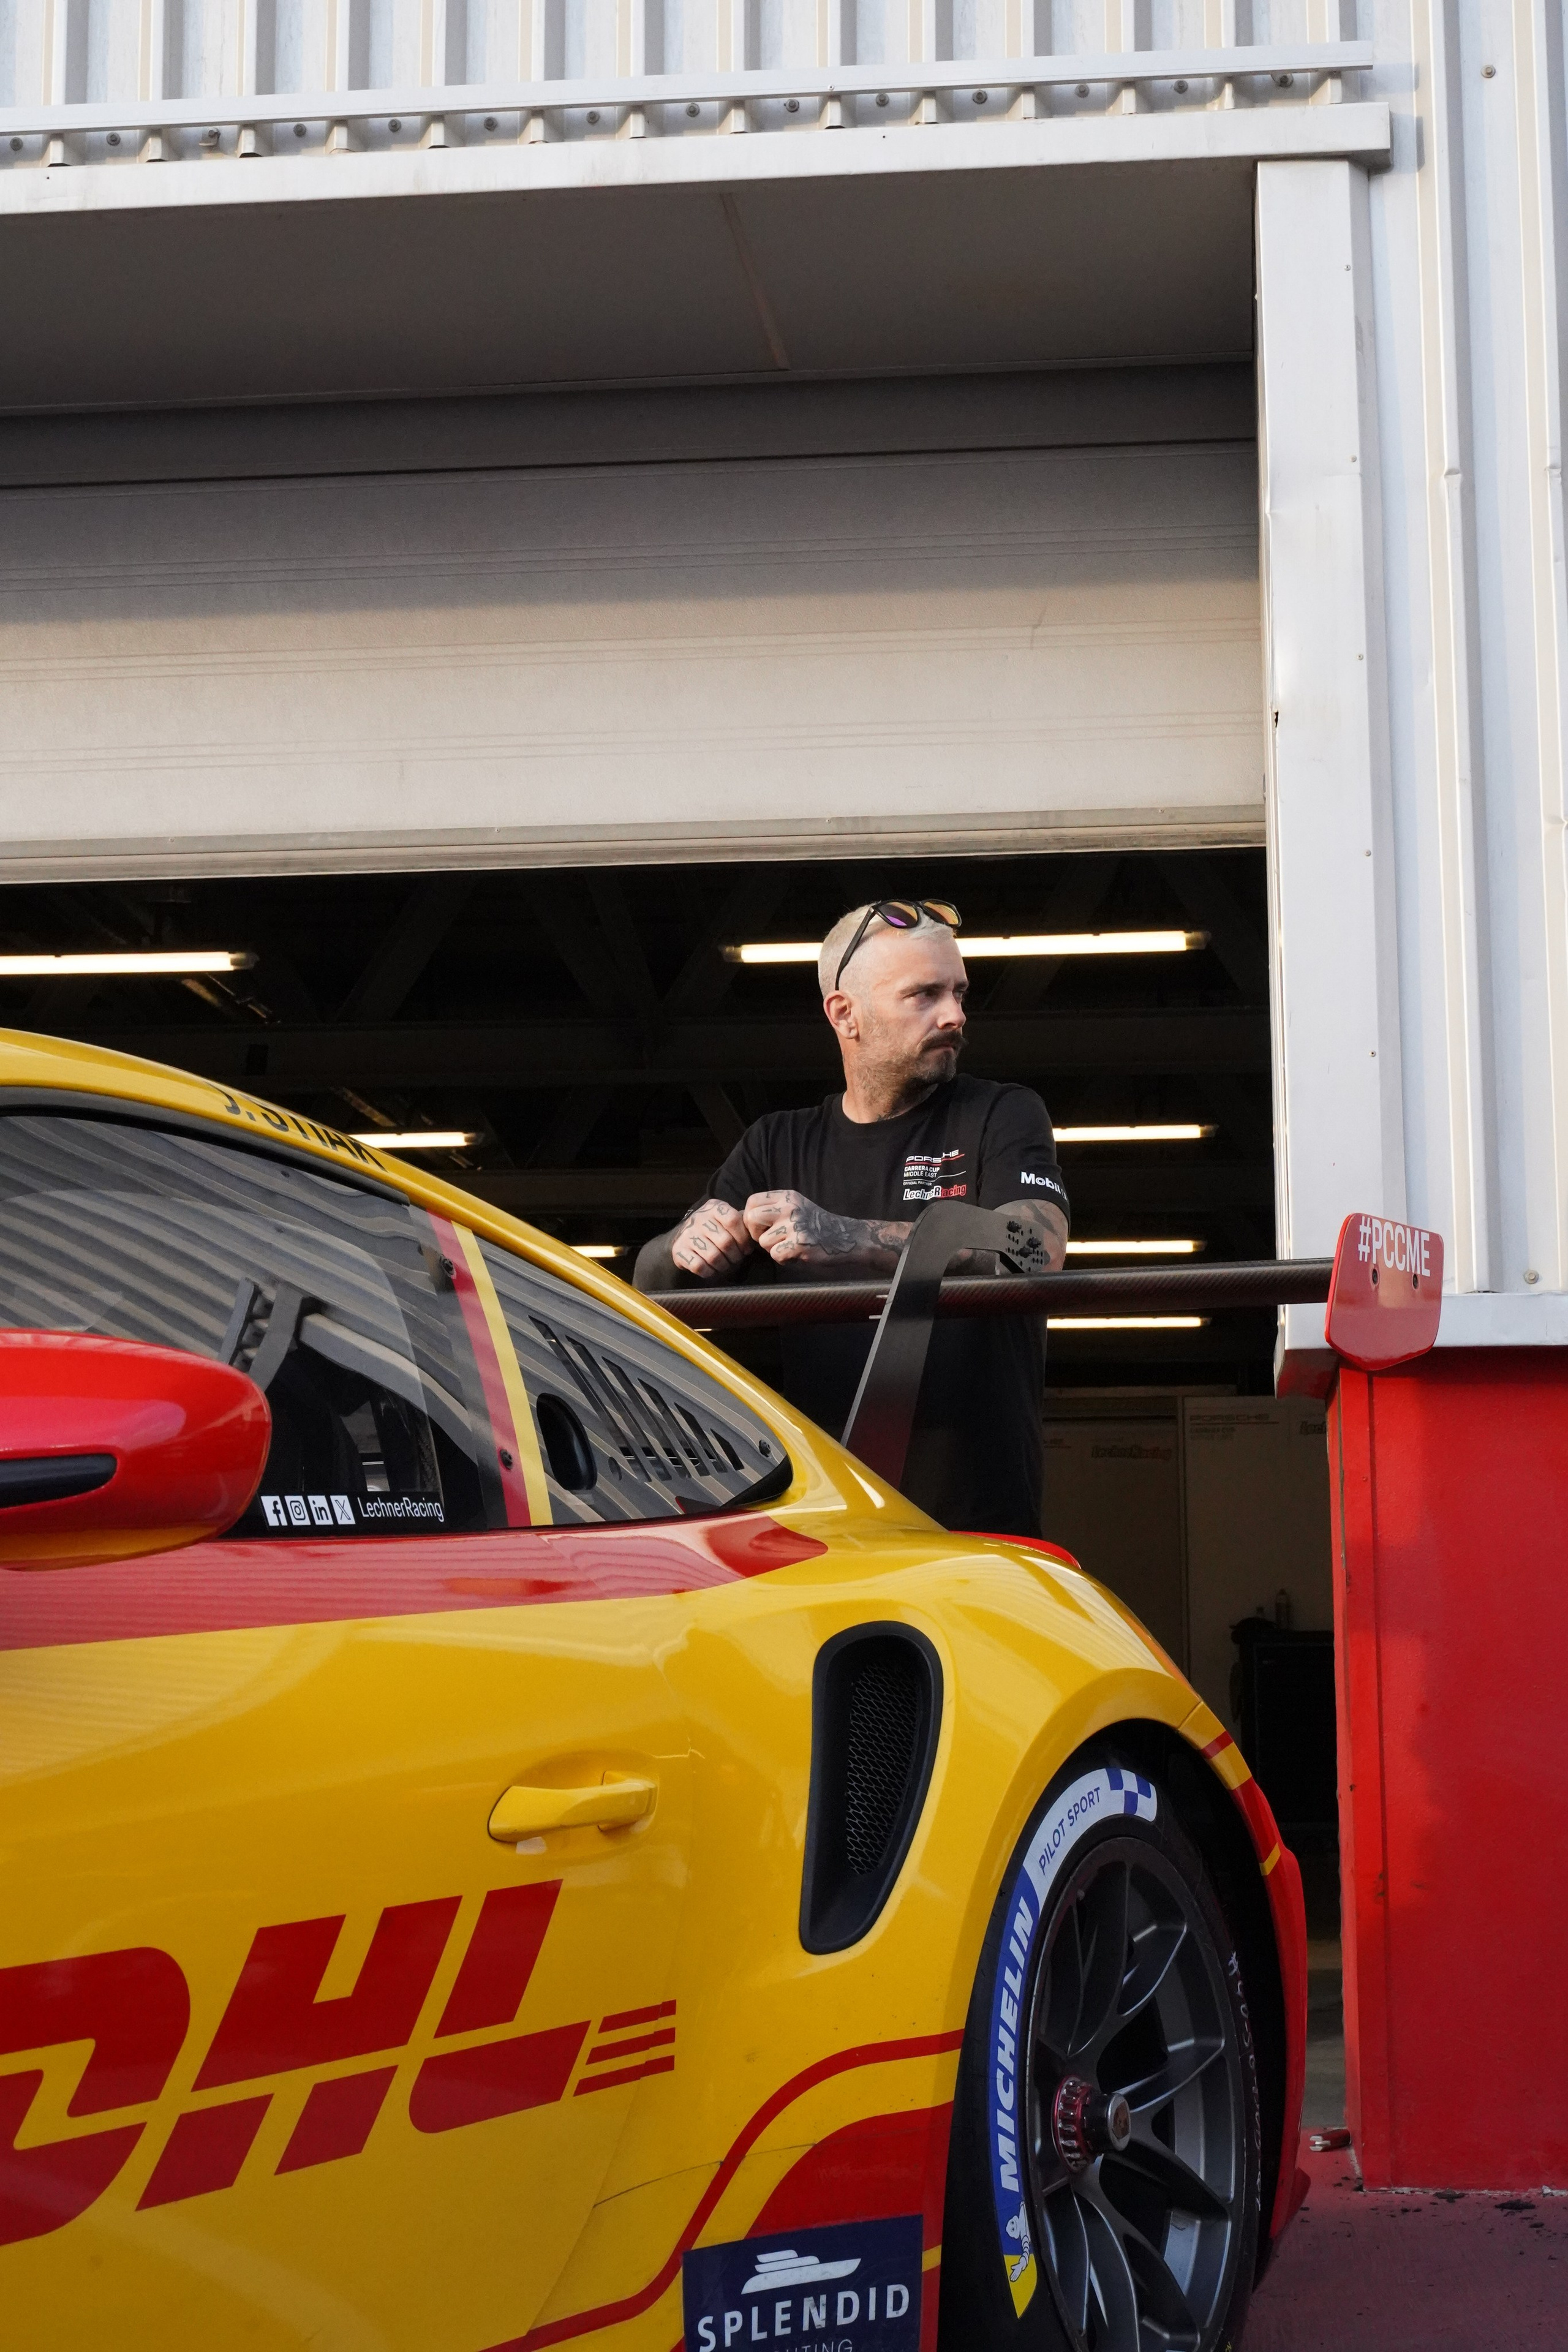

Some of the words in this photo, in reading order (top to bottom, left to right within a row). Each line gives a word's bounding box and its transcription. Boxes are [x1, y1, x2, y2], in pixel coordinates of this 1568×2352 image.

[905, 1149, 959, 1163] PORSHE
[1020, 1171, 1061, 1194] Mobil
[1358, 1216, 1431, 1277] #PCCME
[357, 1496, 445, 1523] LechnerRacing
[1039, 1818, 1065, 1875] PILOT
[1067, 1787, 1100, 1826] SPORT
[996, 1896, 1033, 2193] MICHELIN
[697, 2283, 910, 2352] SPLENDID
